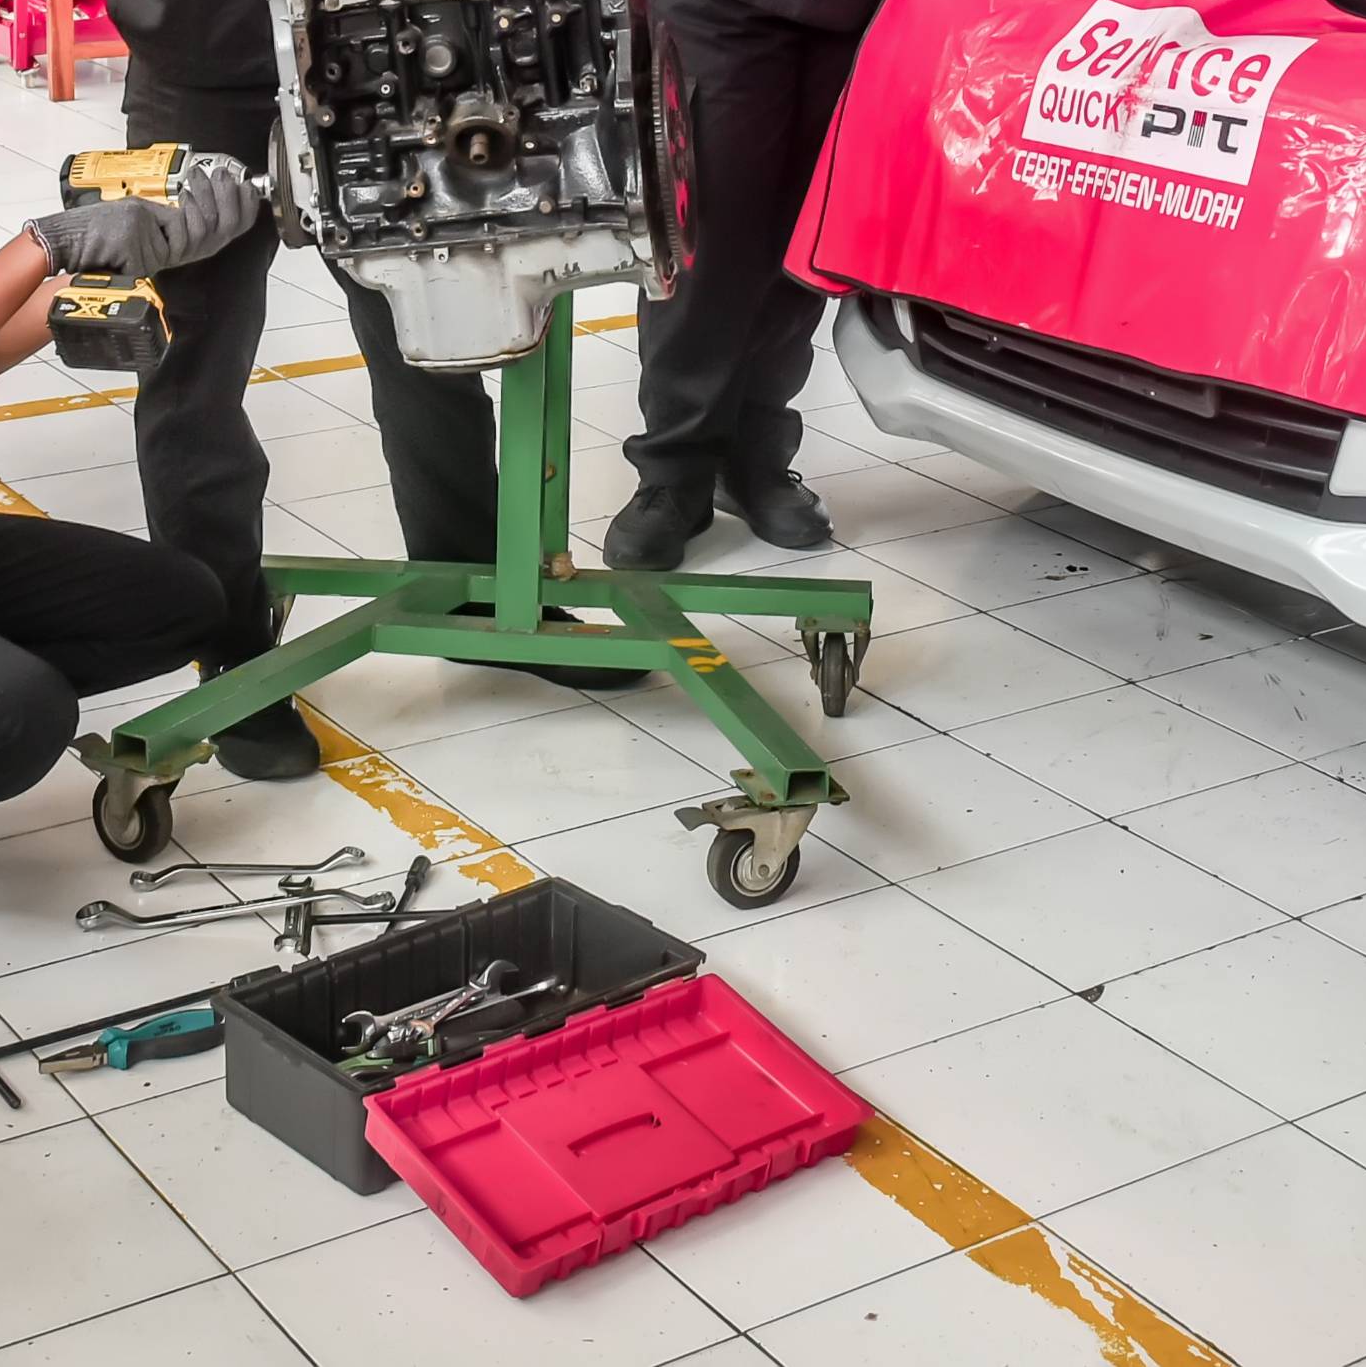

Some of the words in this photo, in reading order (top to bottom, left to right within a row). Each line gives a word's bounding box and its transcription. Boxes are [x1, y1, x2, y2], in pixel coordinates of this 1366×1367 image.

[1056, 19, 1271, 103] Service
[1039, 83, 1124, 132] QUICK
[1141, 103, 1248, 154] PIT
[1011, 150, 1244, 230] CEPAT-EFFISIEN-MUDAH
